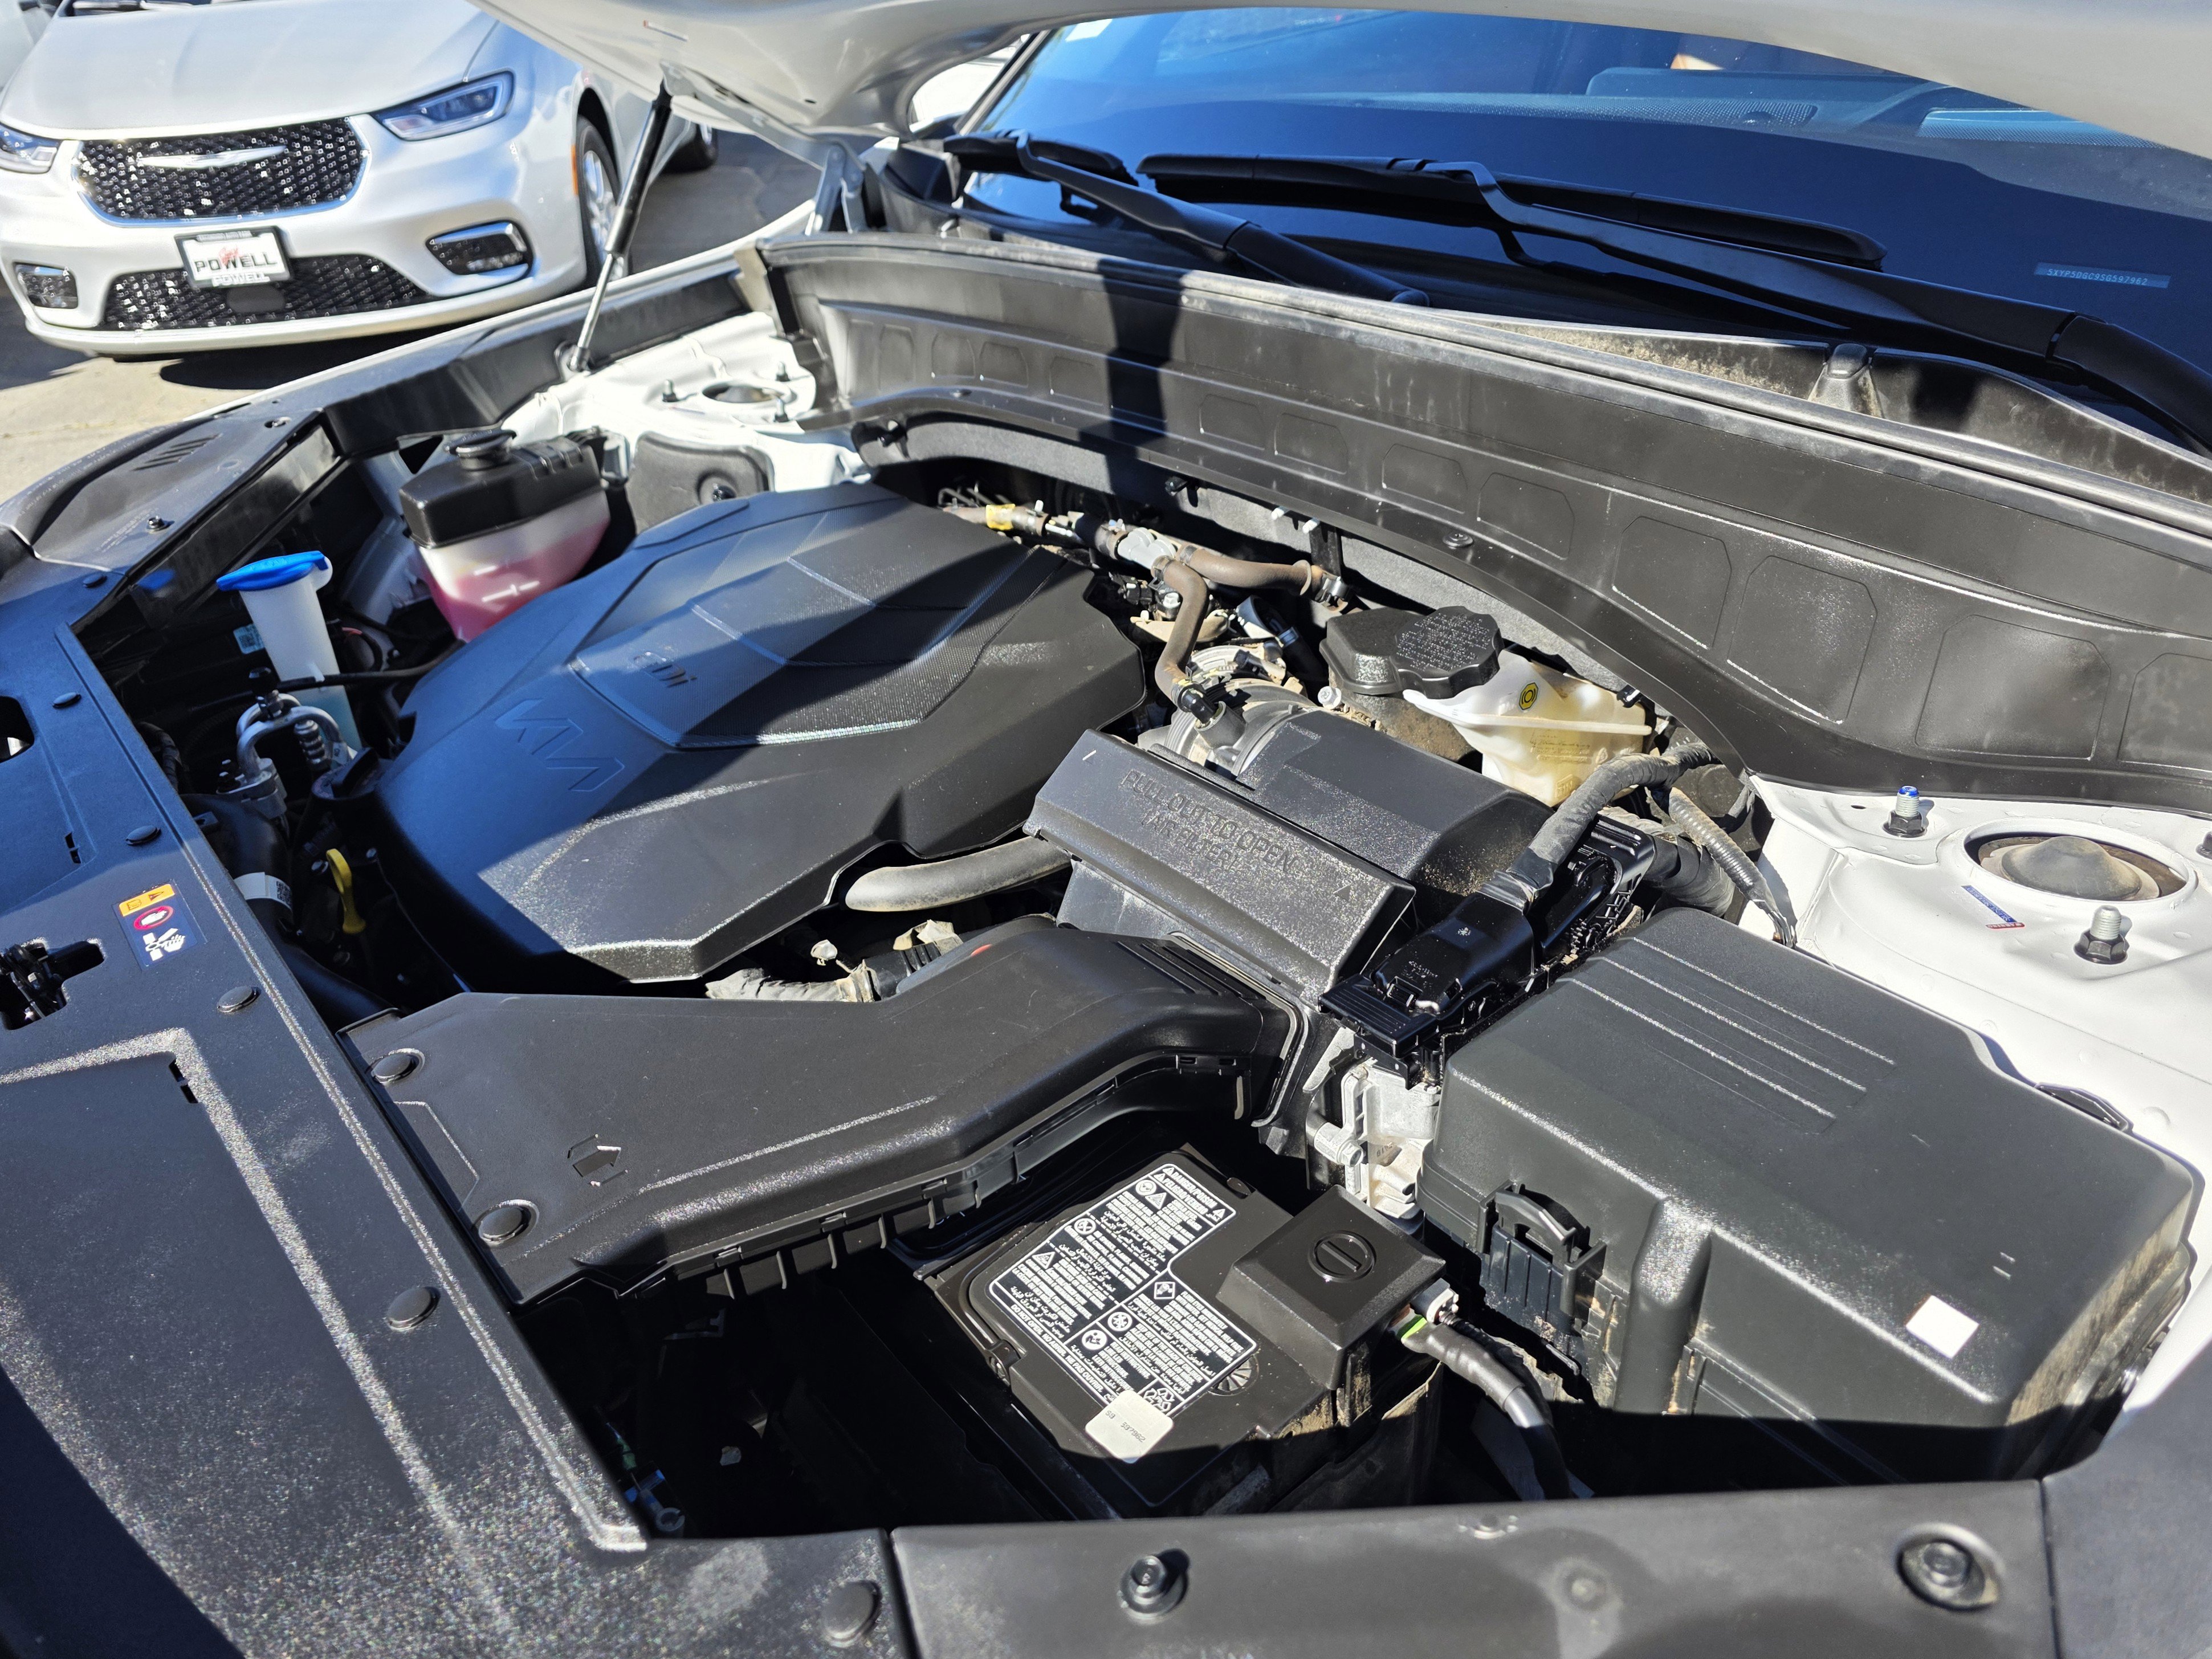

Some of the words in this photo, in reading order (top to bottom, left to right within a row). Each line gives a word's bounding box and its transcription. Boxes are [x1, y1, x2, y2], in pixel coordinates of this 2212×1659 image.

[195, 251, 277, 272] POWELL
[1160, 1177, 1209, 1215] PELIGRO/VENENO
[1170, 1171, 1218, 1208] DANGER/POISON
[1010, 1303, 1021, 1313] DO
[1017, 1310, 1031, 1322] NOT
[1026, 1319, 1044, 1335] OPEN.
[1041, 1333, 1053, 1343] NO
[1048, 1340, 1067, 1357] ABRIR.
[1064, 1355, 1076, 1365] NE
[1071, 1362, 1085, 1374] PAS
[1081, 1371, 1105, 1393] OUVRIR.
